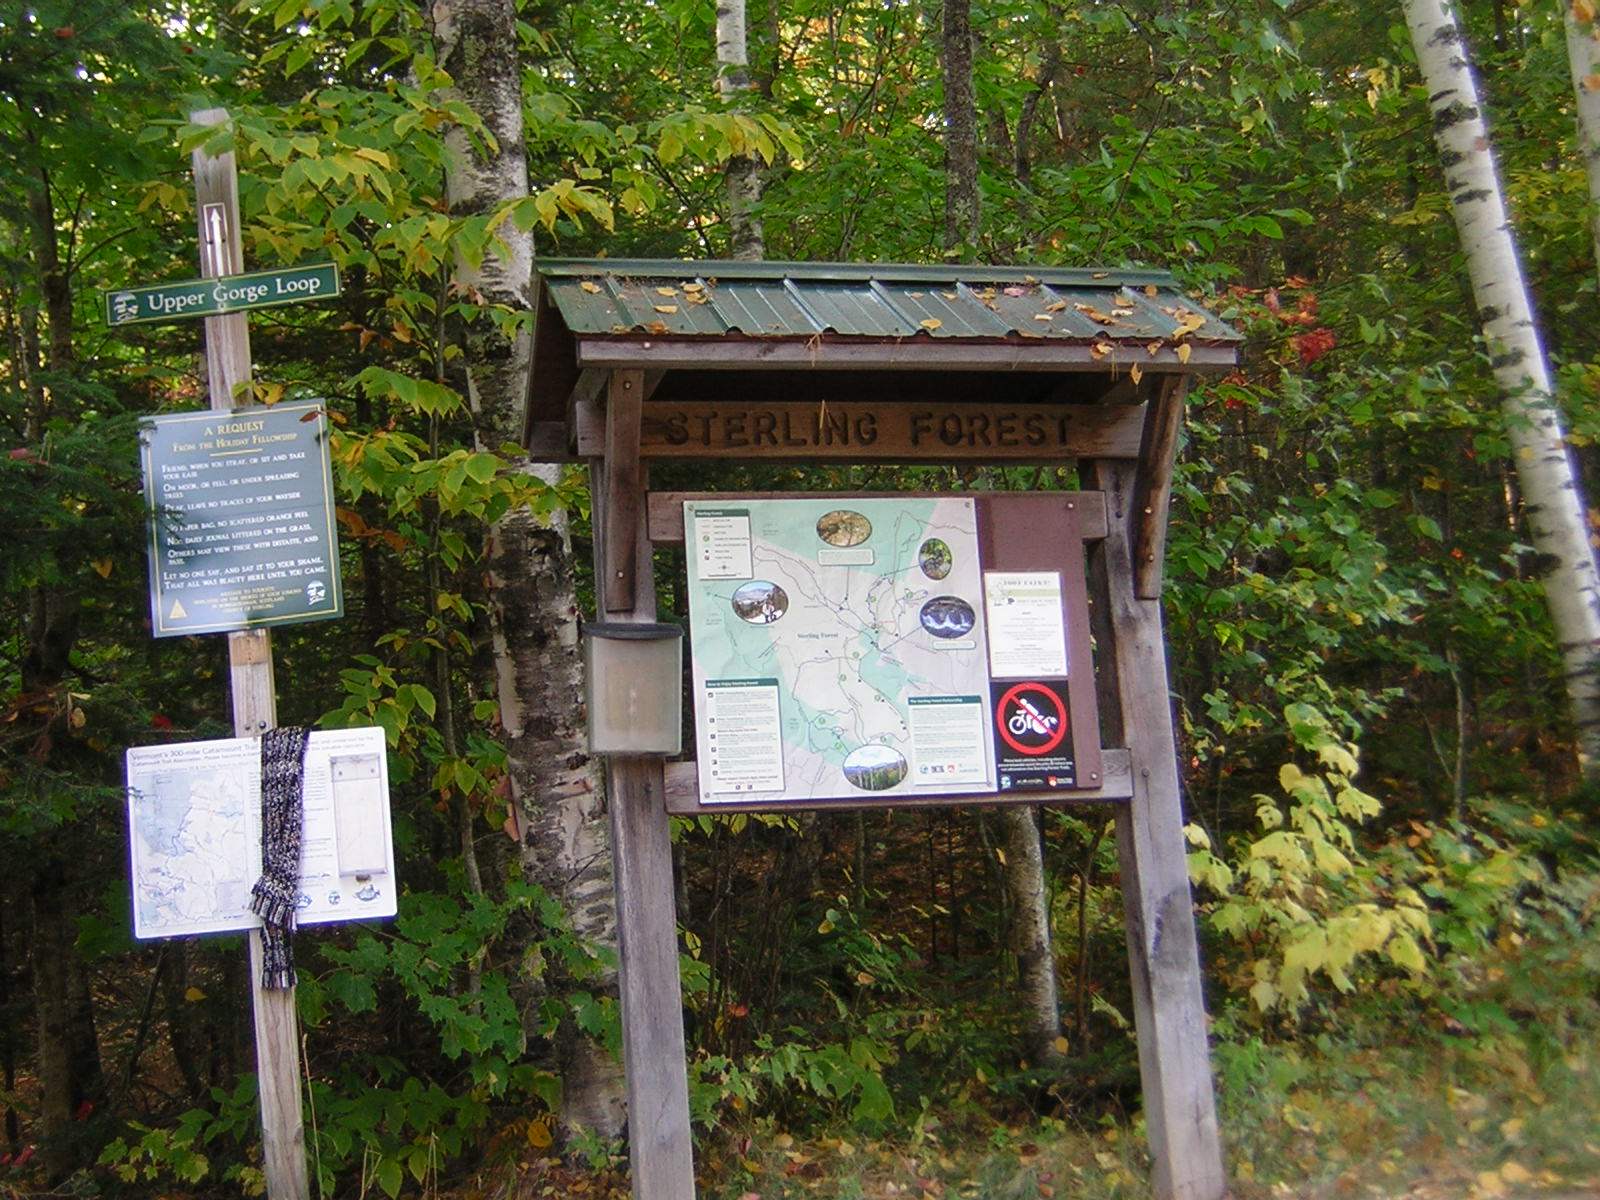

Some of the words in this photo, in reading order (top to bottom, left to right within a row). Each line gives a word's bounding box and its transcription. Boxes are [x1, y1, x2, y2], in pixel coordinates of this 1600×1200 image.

[148, 291, 205, 312] Upper
[213, 283, 268, 302] Gorge
[276, 277, 320, 294] Loop
[203, 426, 212, 435] A
[217, 420, 264, 434] REQUEST
[665, 411, 878, 447] STERLING
[911, 411, 1072, 448] FOREST
[216, 435, 249, 448] HOLIDAY
[252, 431, 297, 444] FELLOWSHIP
[288, 450, 304, 458] TAKE
[264, 471, 299, 480] SPREADING
[266, 512, 291, 520] ORANGE
[224, 566, 240, 574] AND
[164, 579, 184, 589] THAT
[219, 575, 244, 583] BEAUTY
[289, 568, 302, 576] YOU
